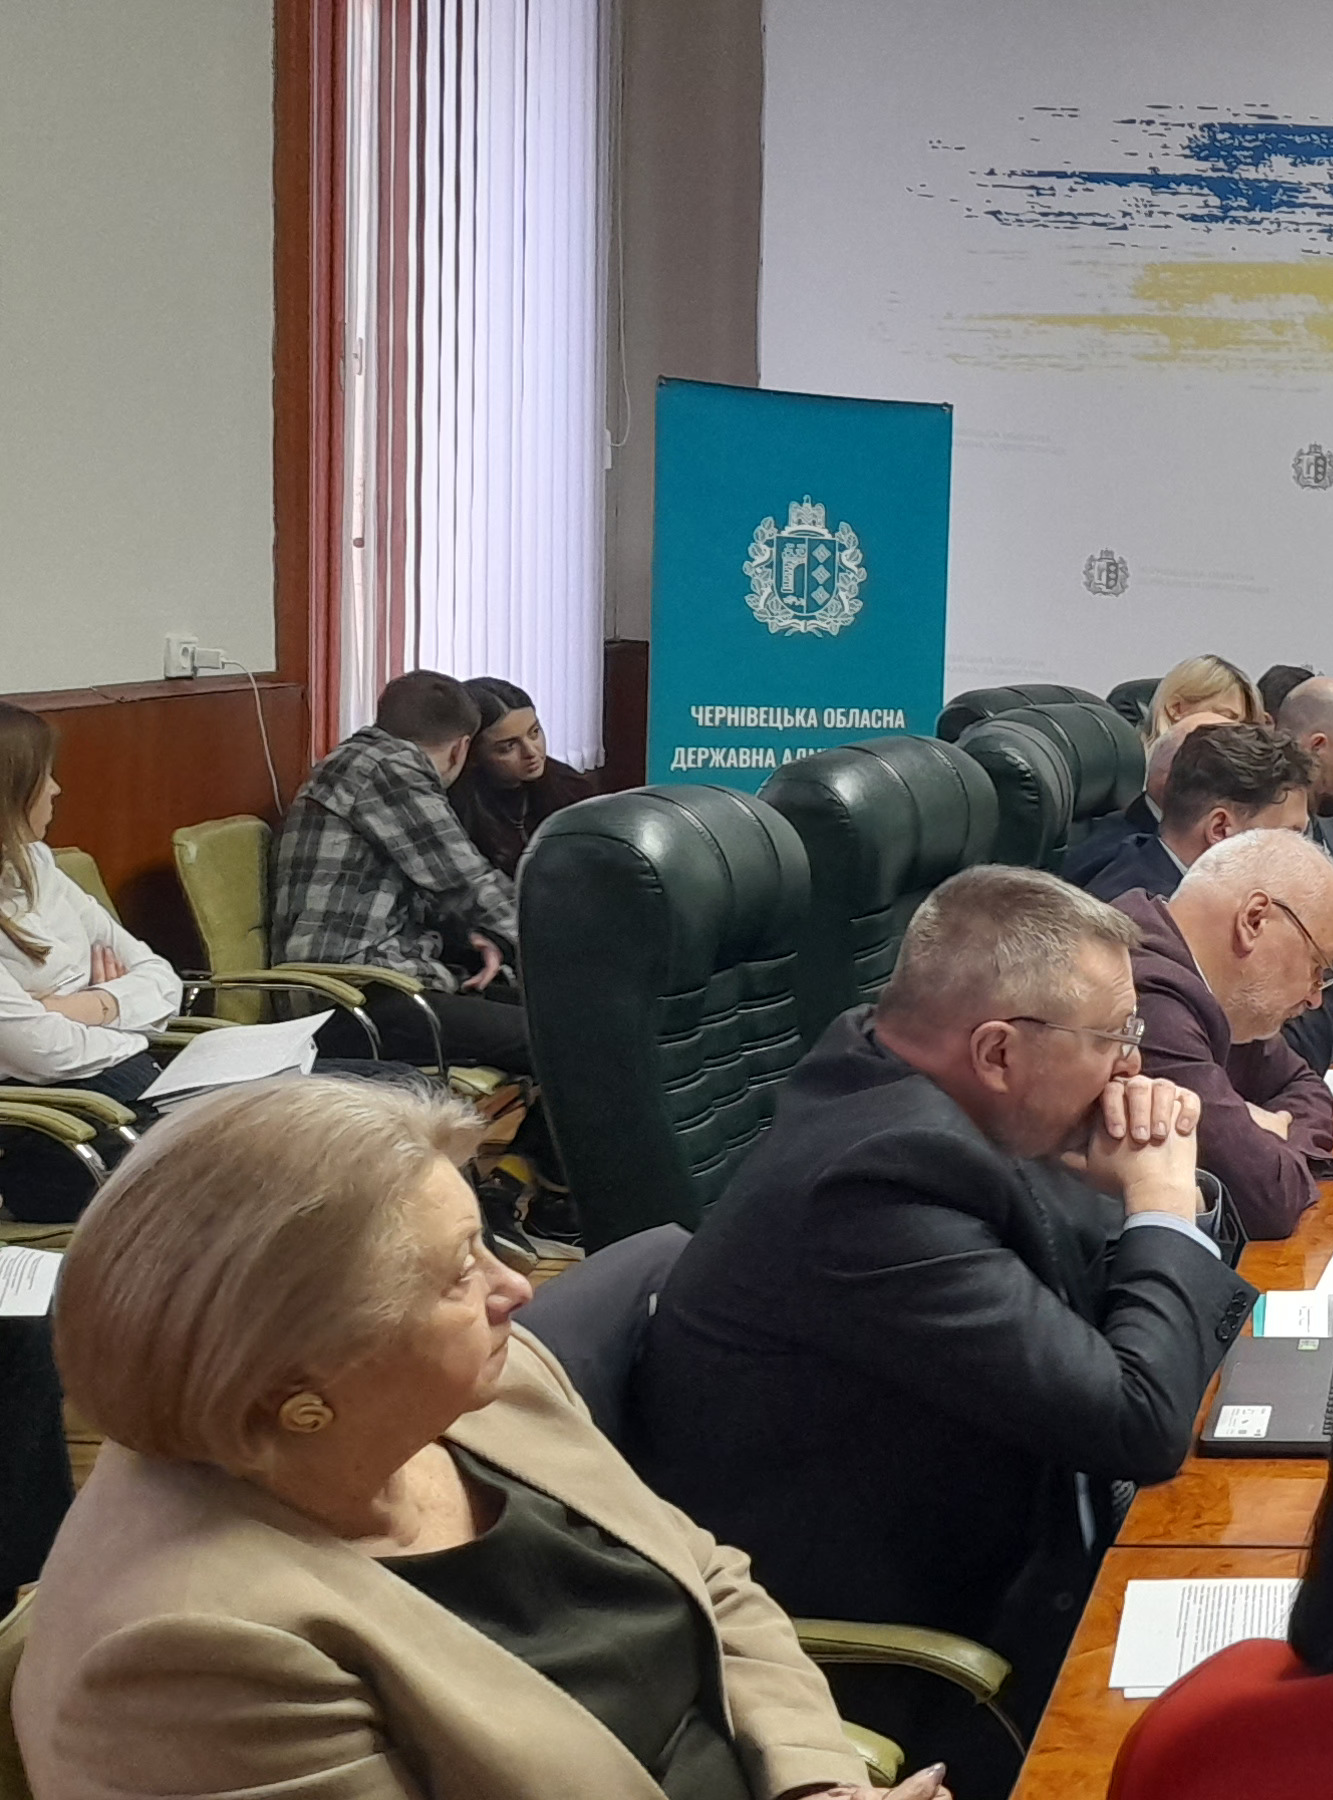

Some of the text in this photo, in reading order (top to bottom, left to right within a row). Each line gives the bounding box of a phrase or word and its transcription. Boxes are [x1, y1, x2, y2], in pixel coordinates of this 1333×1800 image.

[690, 705, 906, 731] ЧЕРНІВЕЦЬКА ОБЛАСНА
[670, 747, 777, 772] ДЕРЖАВНА
